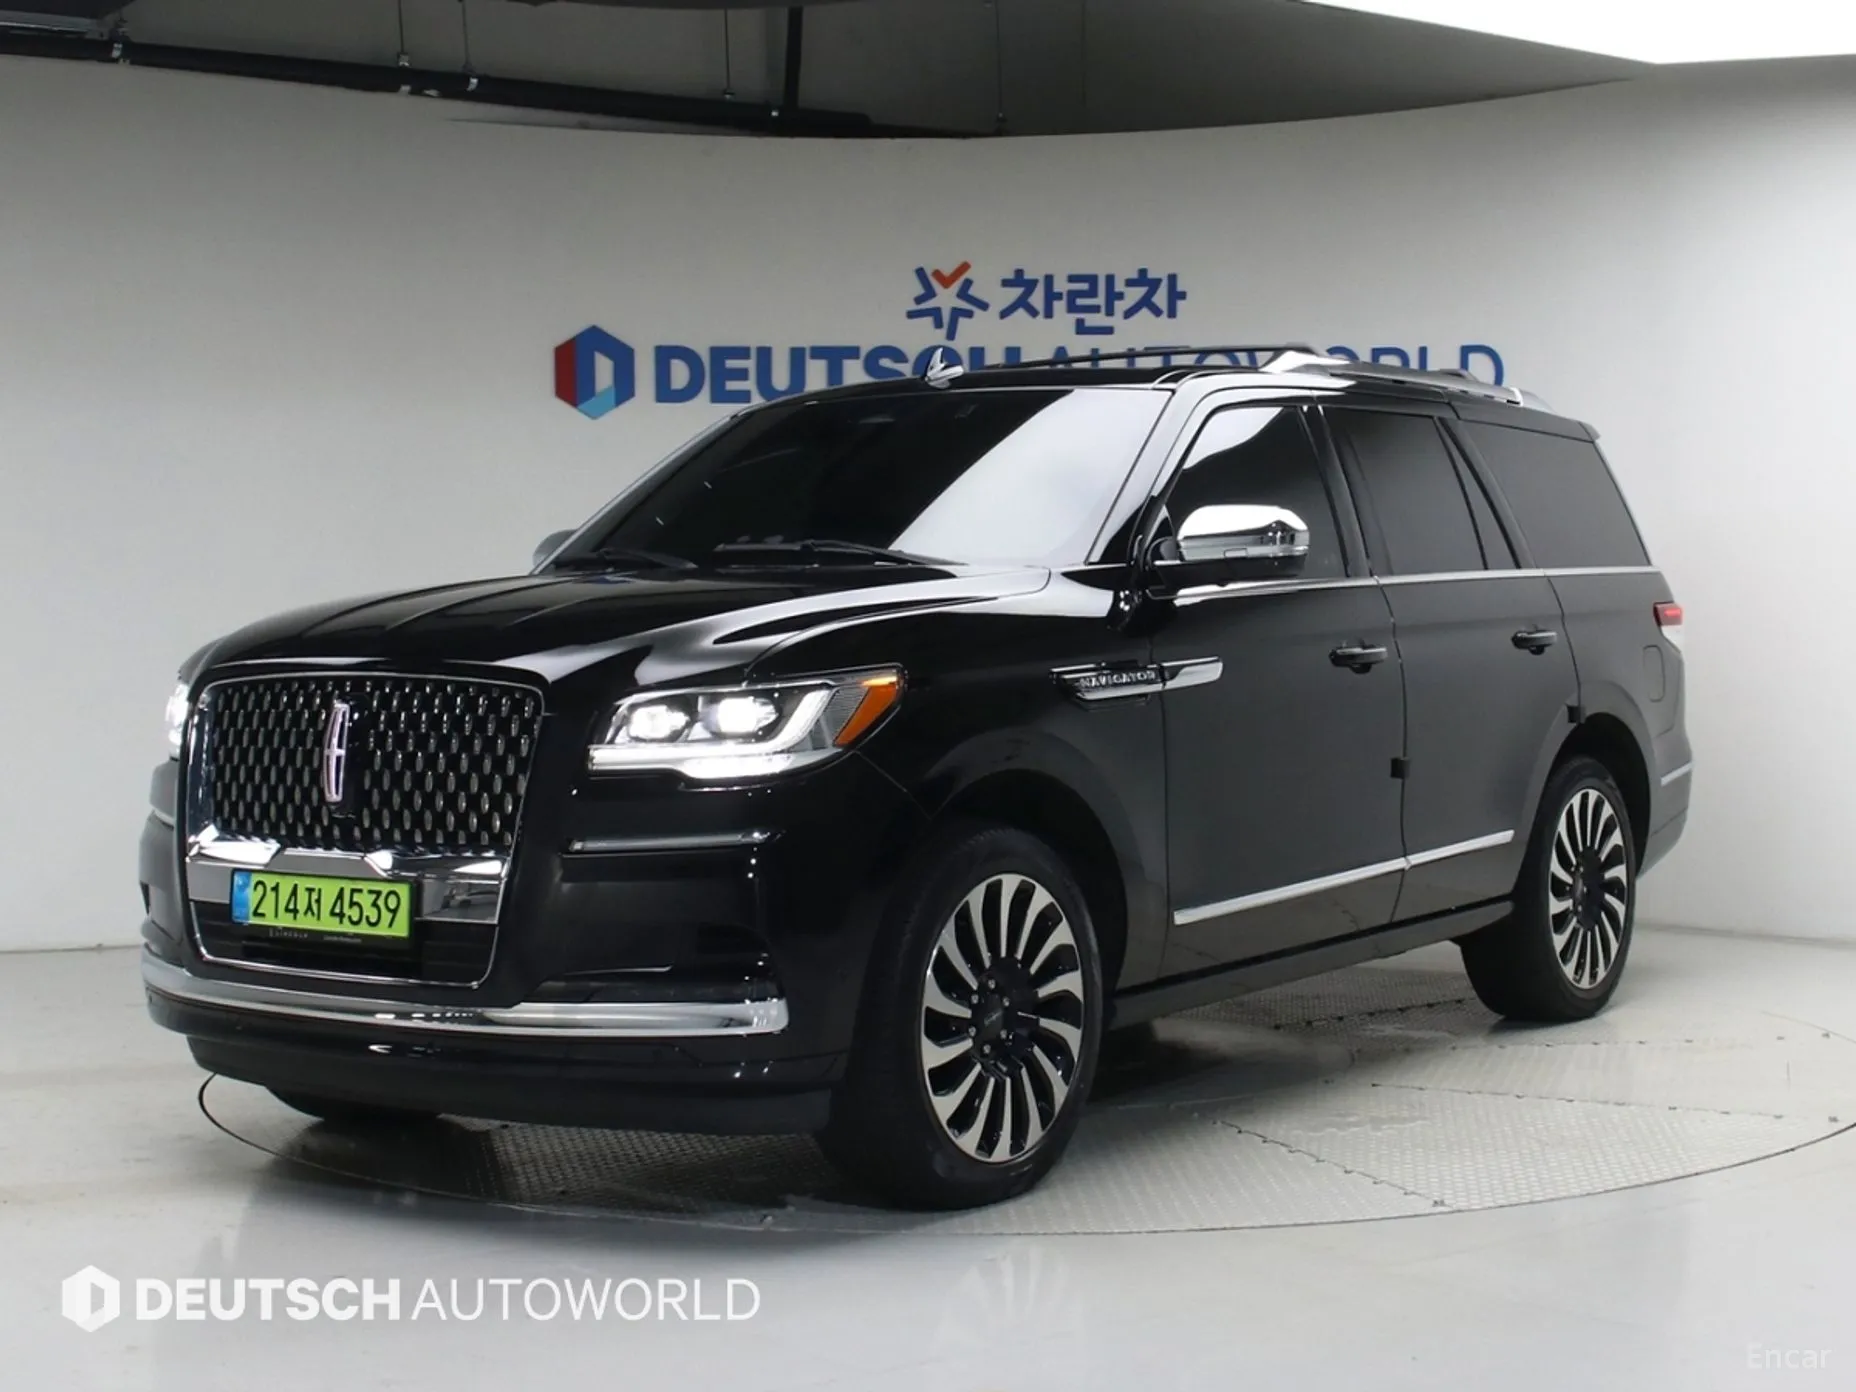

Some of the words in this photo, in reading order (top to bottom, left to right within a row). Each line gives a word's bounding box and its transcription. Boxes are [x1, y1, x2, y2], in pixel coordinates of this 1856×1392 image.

[998, 267, 1187, 336] 차란차
[1078, 669, 1156, 688] NAVIGATOR
[252, 879, 322, 922] 214저
[329, 886, 402, 929] 4539
